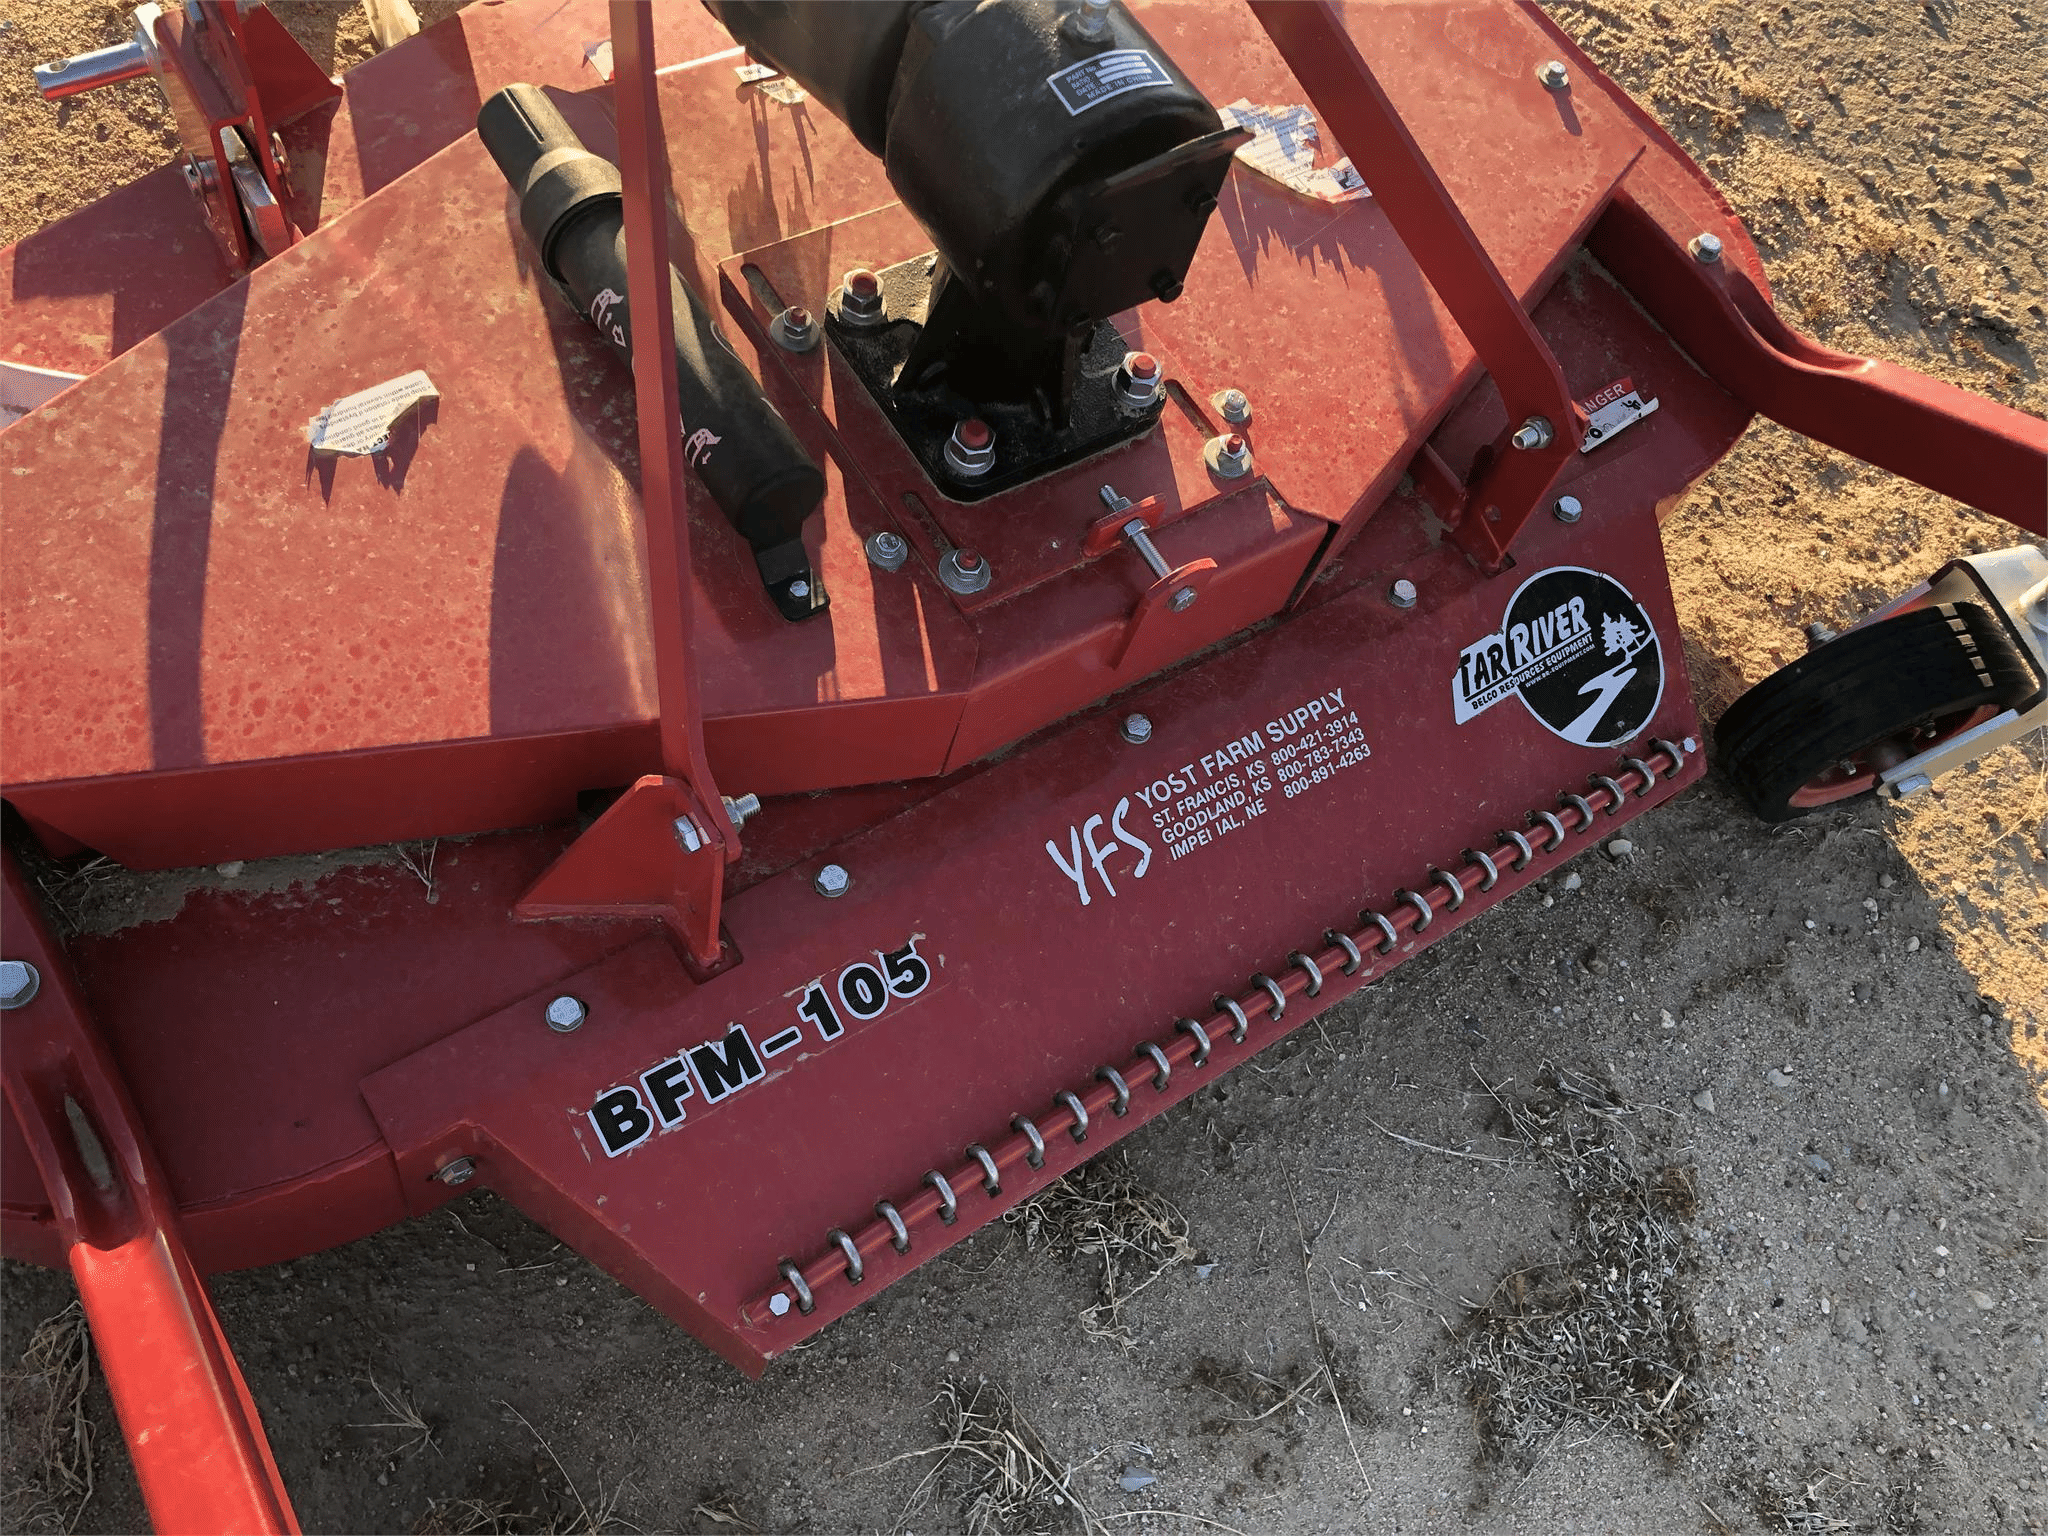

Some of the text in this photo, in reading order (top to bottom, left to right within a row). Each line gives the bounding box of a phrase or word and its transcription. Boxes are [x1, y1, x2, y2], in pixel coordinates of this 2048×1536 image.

[1087, 73, 1151, 99] MADE IN CHINA
[1582, 383, 1625, 414] ANGER
[1459, 595, 1591, 697] TAR RIVER
[1471, 633, 1594, 709] BELCO RESOURCES EQUIPMENT
[1135, 687, 1348, 809] YOST FARM SUPPLY
[1152, 711, 1359, 828] ST. FRANCIS, KS 800-421-3914
[1161, 728, 1365, 845] GOODLAND, KS 800-783-7343
[1246, 798, 1267, 820] NE
[1282, 743, 1372, 800] 800-891-4263
[1045, 797, 1152, 906] YFS
[587, 942, 932, 1158] BFM-105
